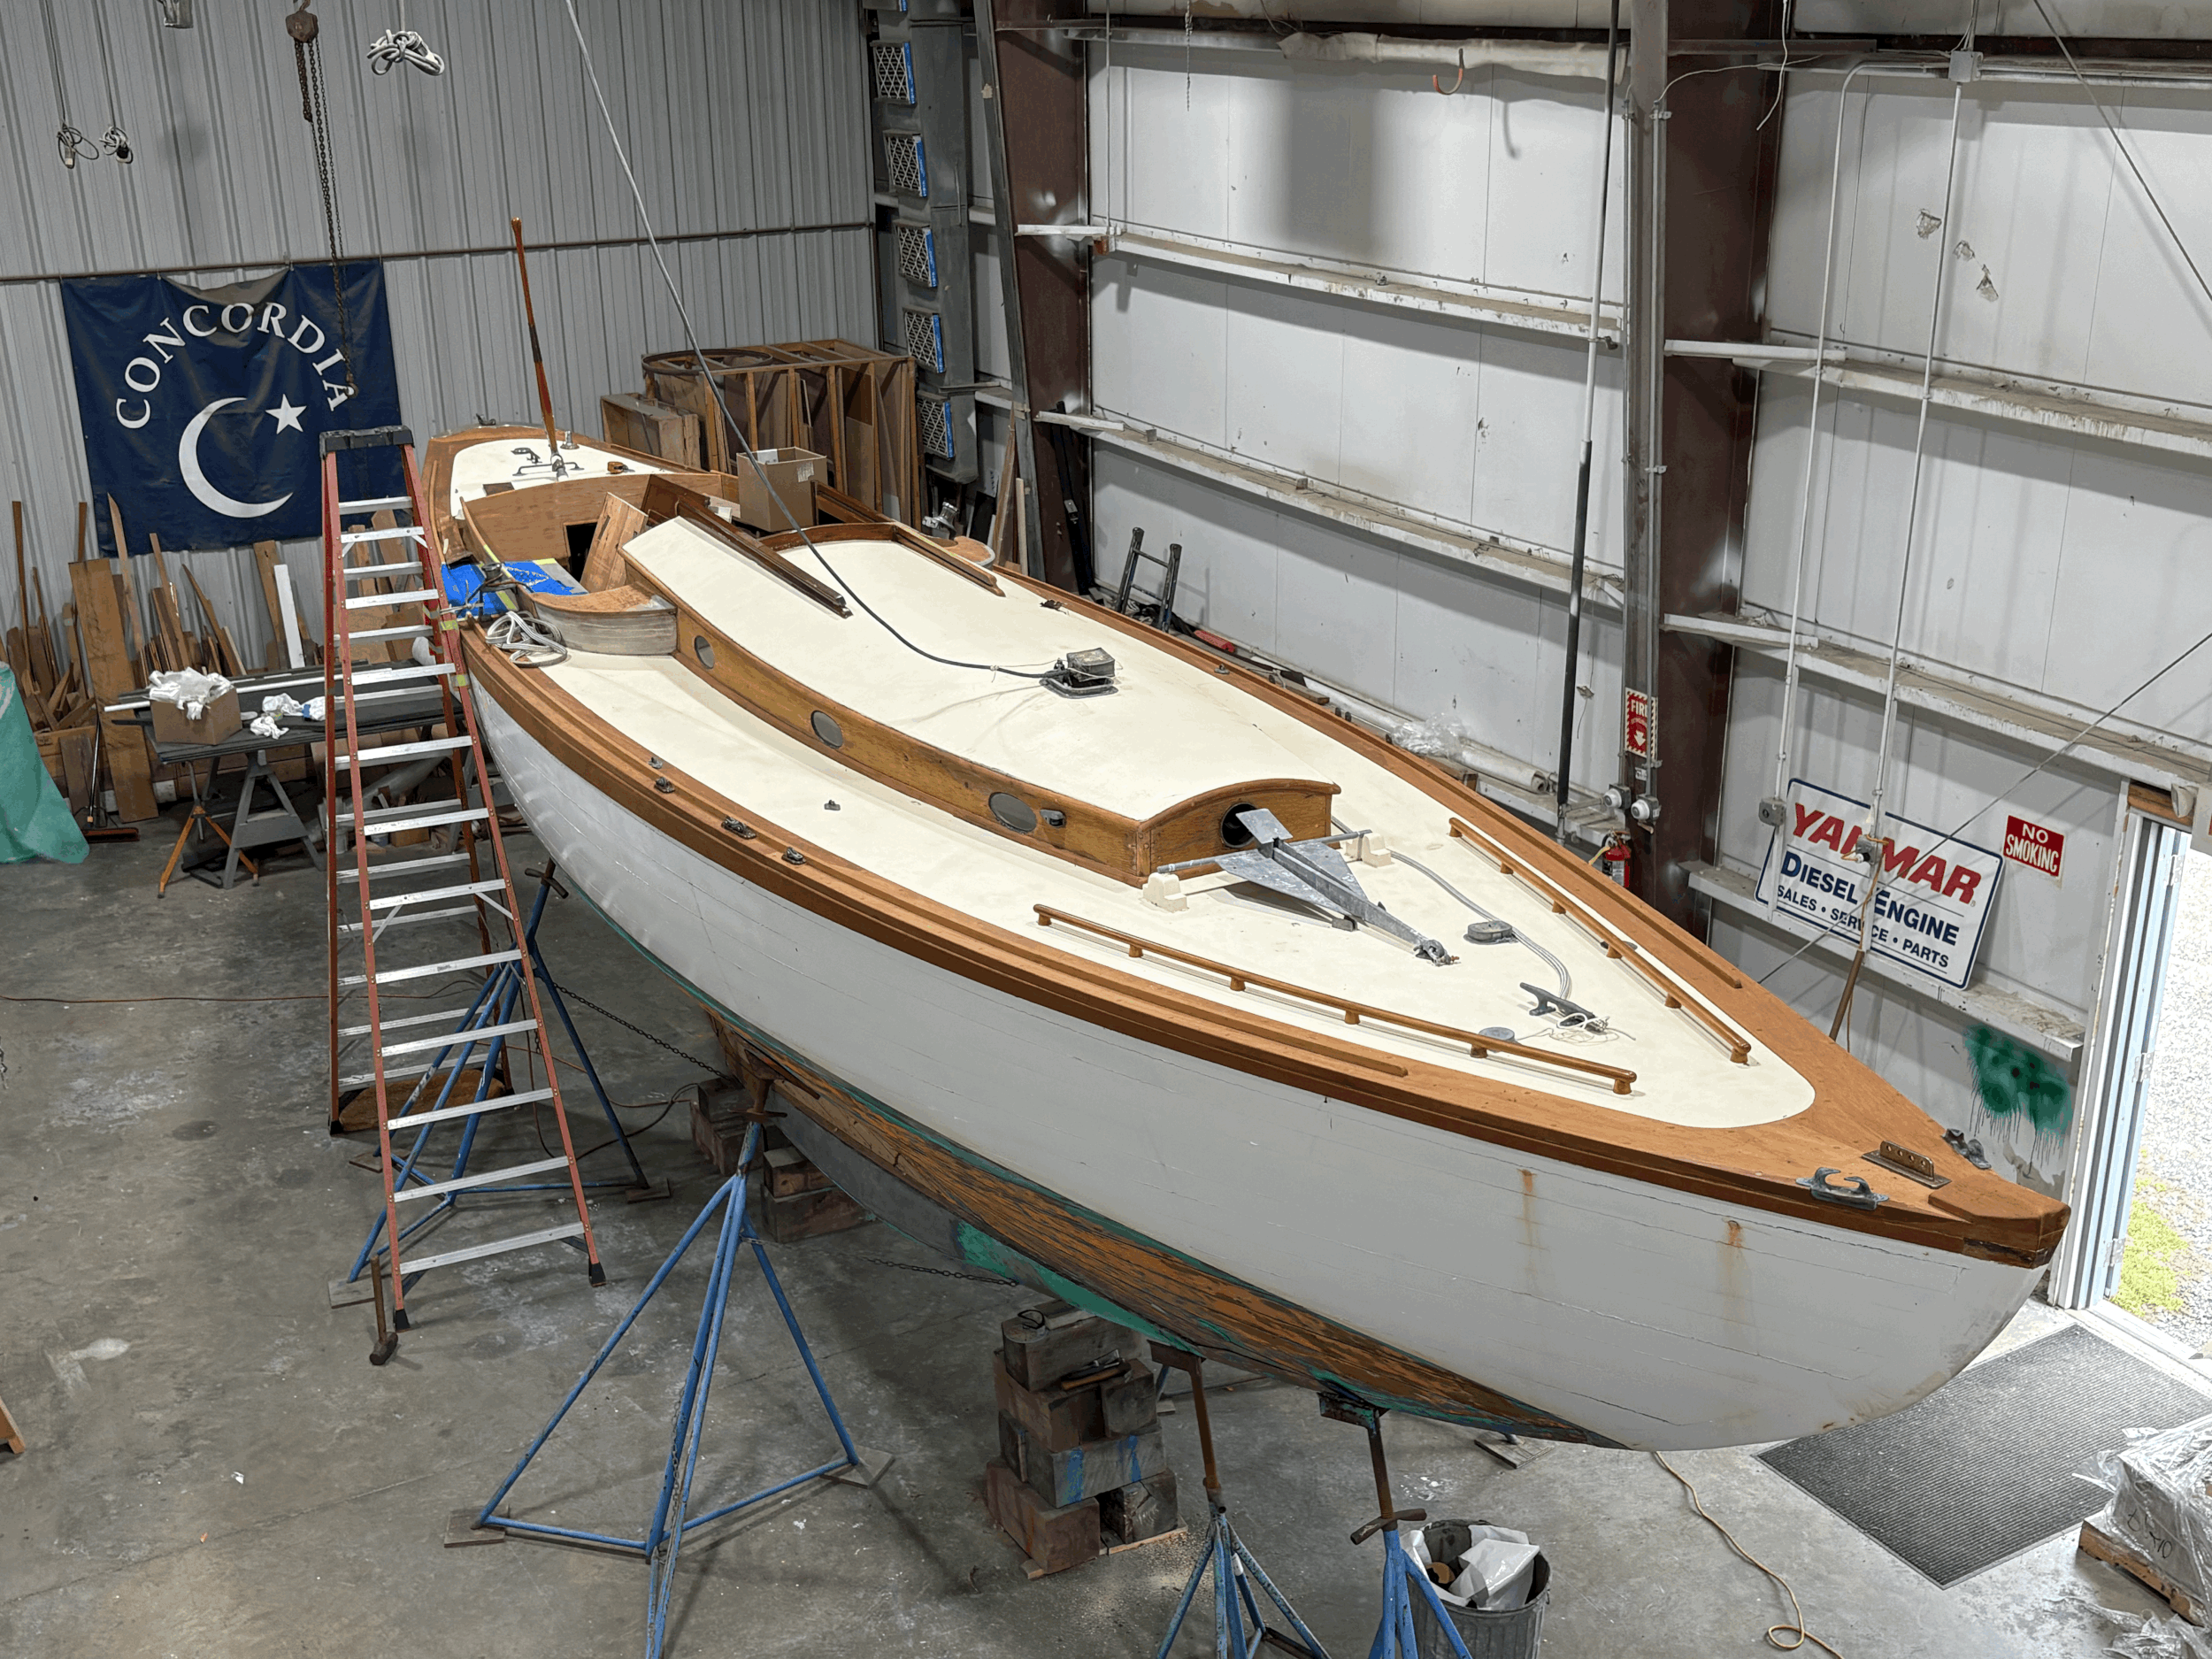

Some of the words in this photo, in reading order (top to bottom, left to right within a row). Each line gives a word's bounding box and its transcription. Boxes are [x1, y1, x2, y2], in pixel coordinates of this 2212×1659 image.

[116, 303, 355, 429] CONCORDIA
[2006, 834, 2059, 872] SMOKING
[2022, 823, 2048, 843] NO
[1777, 886, 1816, 911] SALES
[1901, 939, 1949, 968] PARTS
[1780, 851, 1858, 904] DIESEL
[1874, 887, 1960, 946] ENGINE
